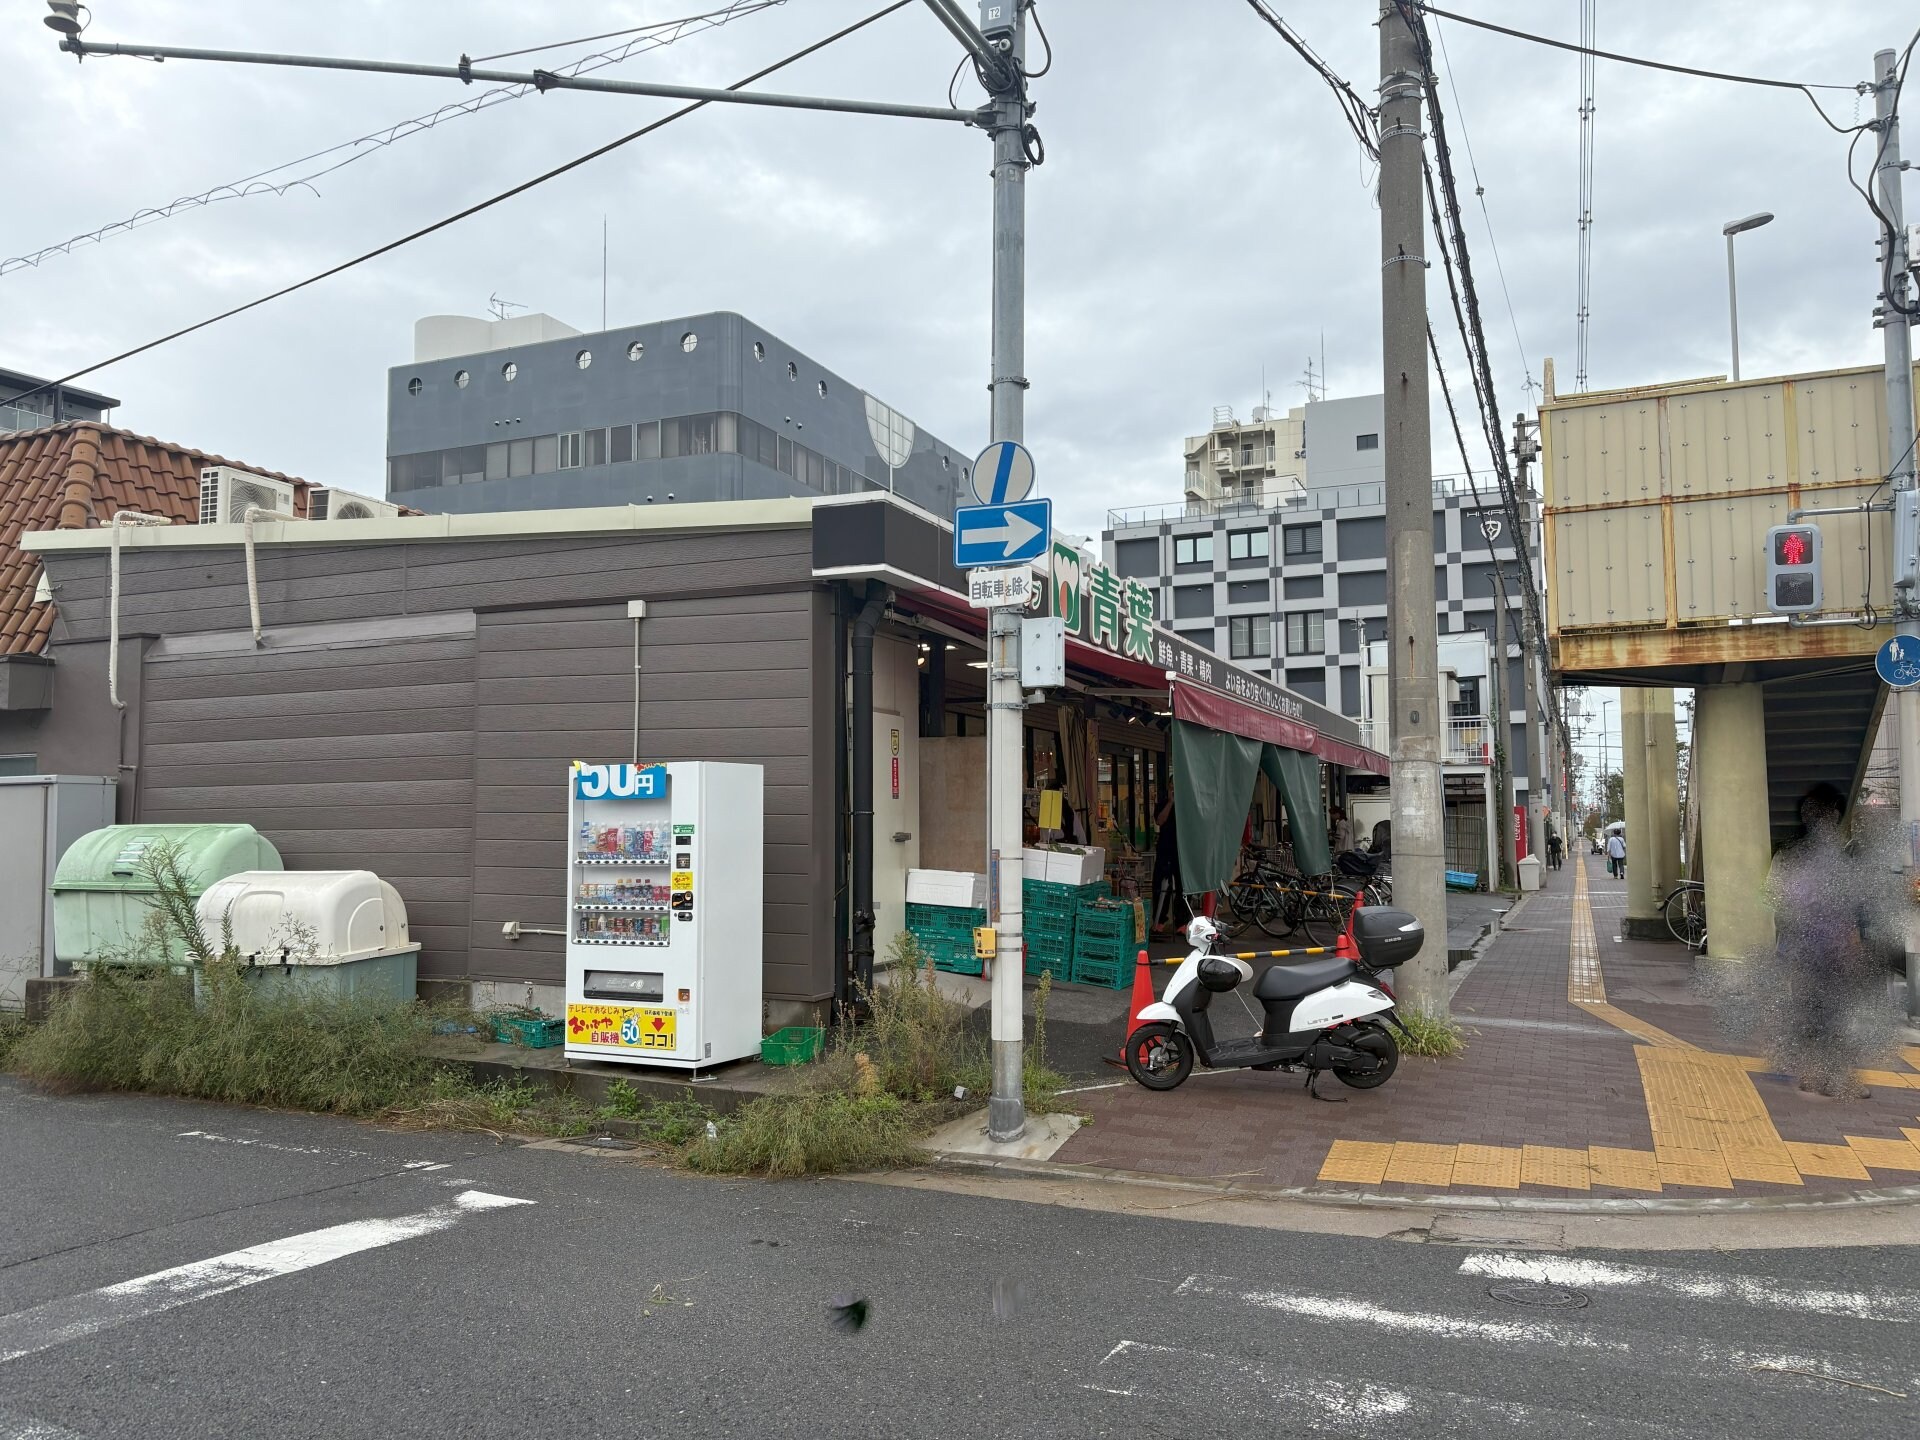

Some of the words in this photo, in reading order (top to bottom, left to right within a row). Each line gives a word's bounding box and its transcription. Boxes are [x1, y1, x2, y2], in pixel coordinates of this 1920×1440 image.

[989, 7, 1000, 19] T2
[971, 576, 1030, 600] 自転車を除く
[1086, 561, 1154, 665] 青葉
[1158, 639, 1212, 684] 鮮魚・青果・精肉
[568, 1004, 620, 1015] テレビでおなじみ
[568, 1016, 613, 1035] おいでや
[591, 1030, 620, 1044] 自販機
[644, 1033, 674, 1048] ココ!
